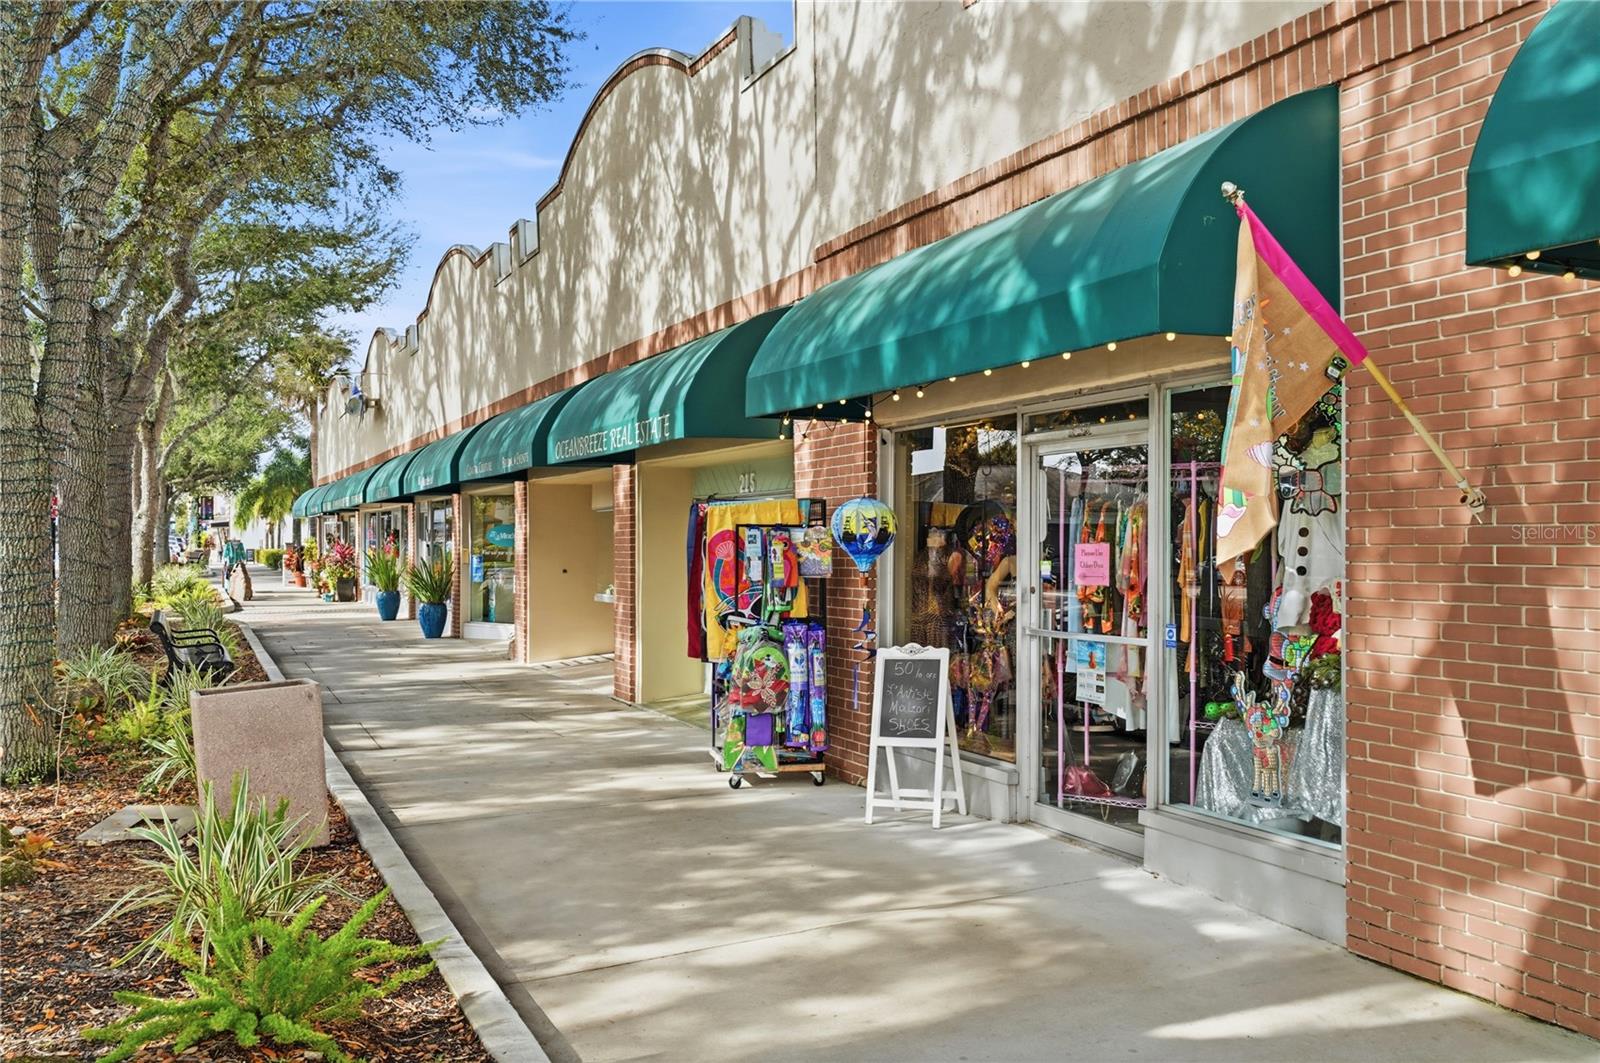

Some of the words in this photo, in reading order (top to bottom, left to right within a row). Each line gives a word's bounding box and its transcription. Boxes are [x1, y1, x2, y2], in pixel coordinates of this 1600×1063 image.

[555, 431, 608, 460] OCEANBREEZE
[609, 424, 633, 450] REAL
[635, 413, 670, 444] ESTATE
[739, 473, 756, 493] 215
[894, 661, 914, 677] 50
